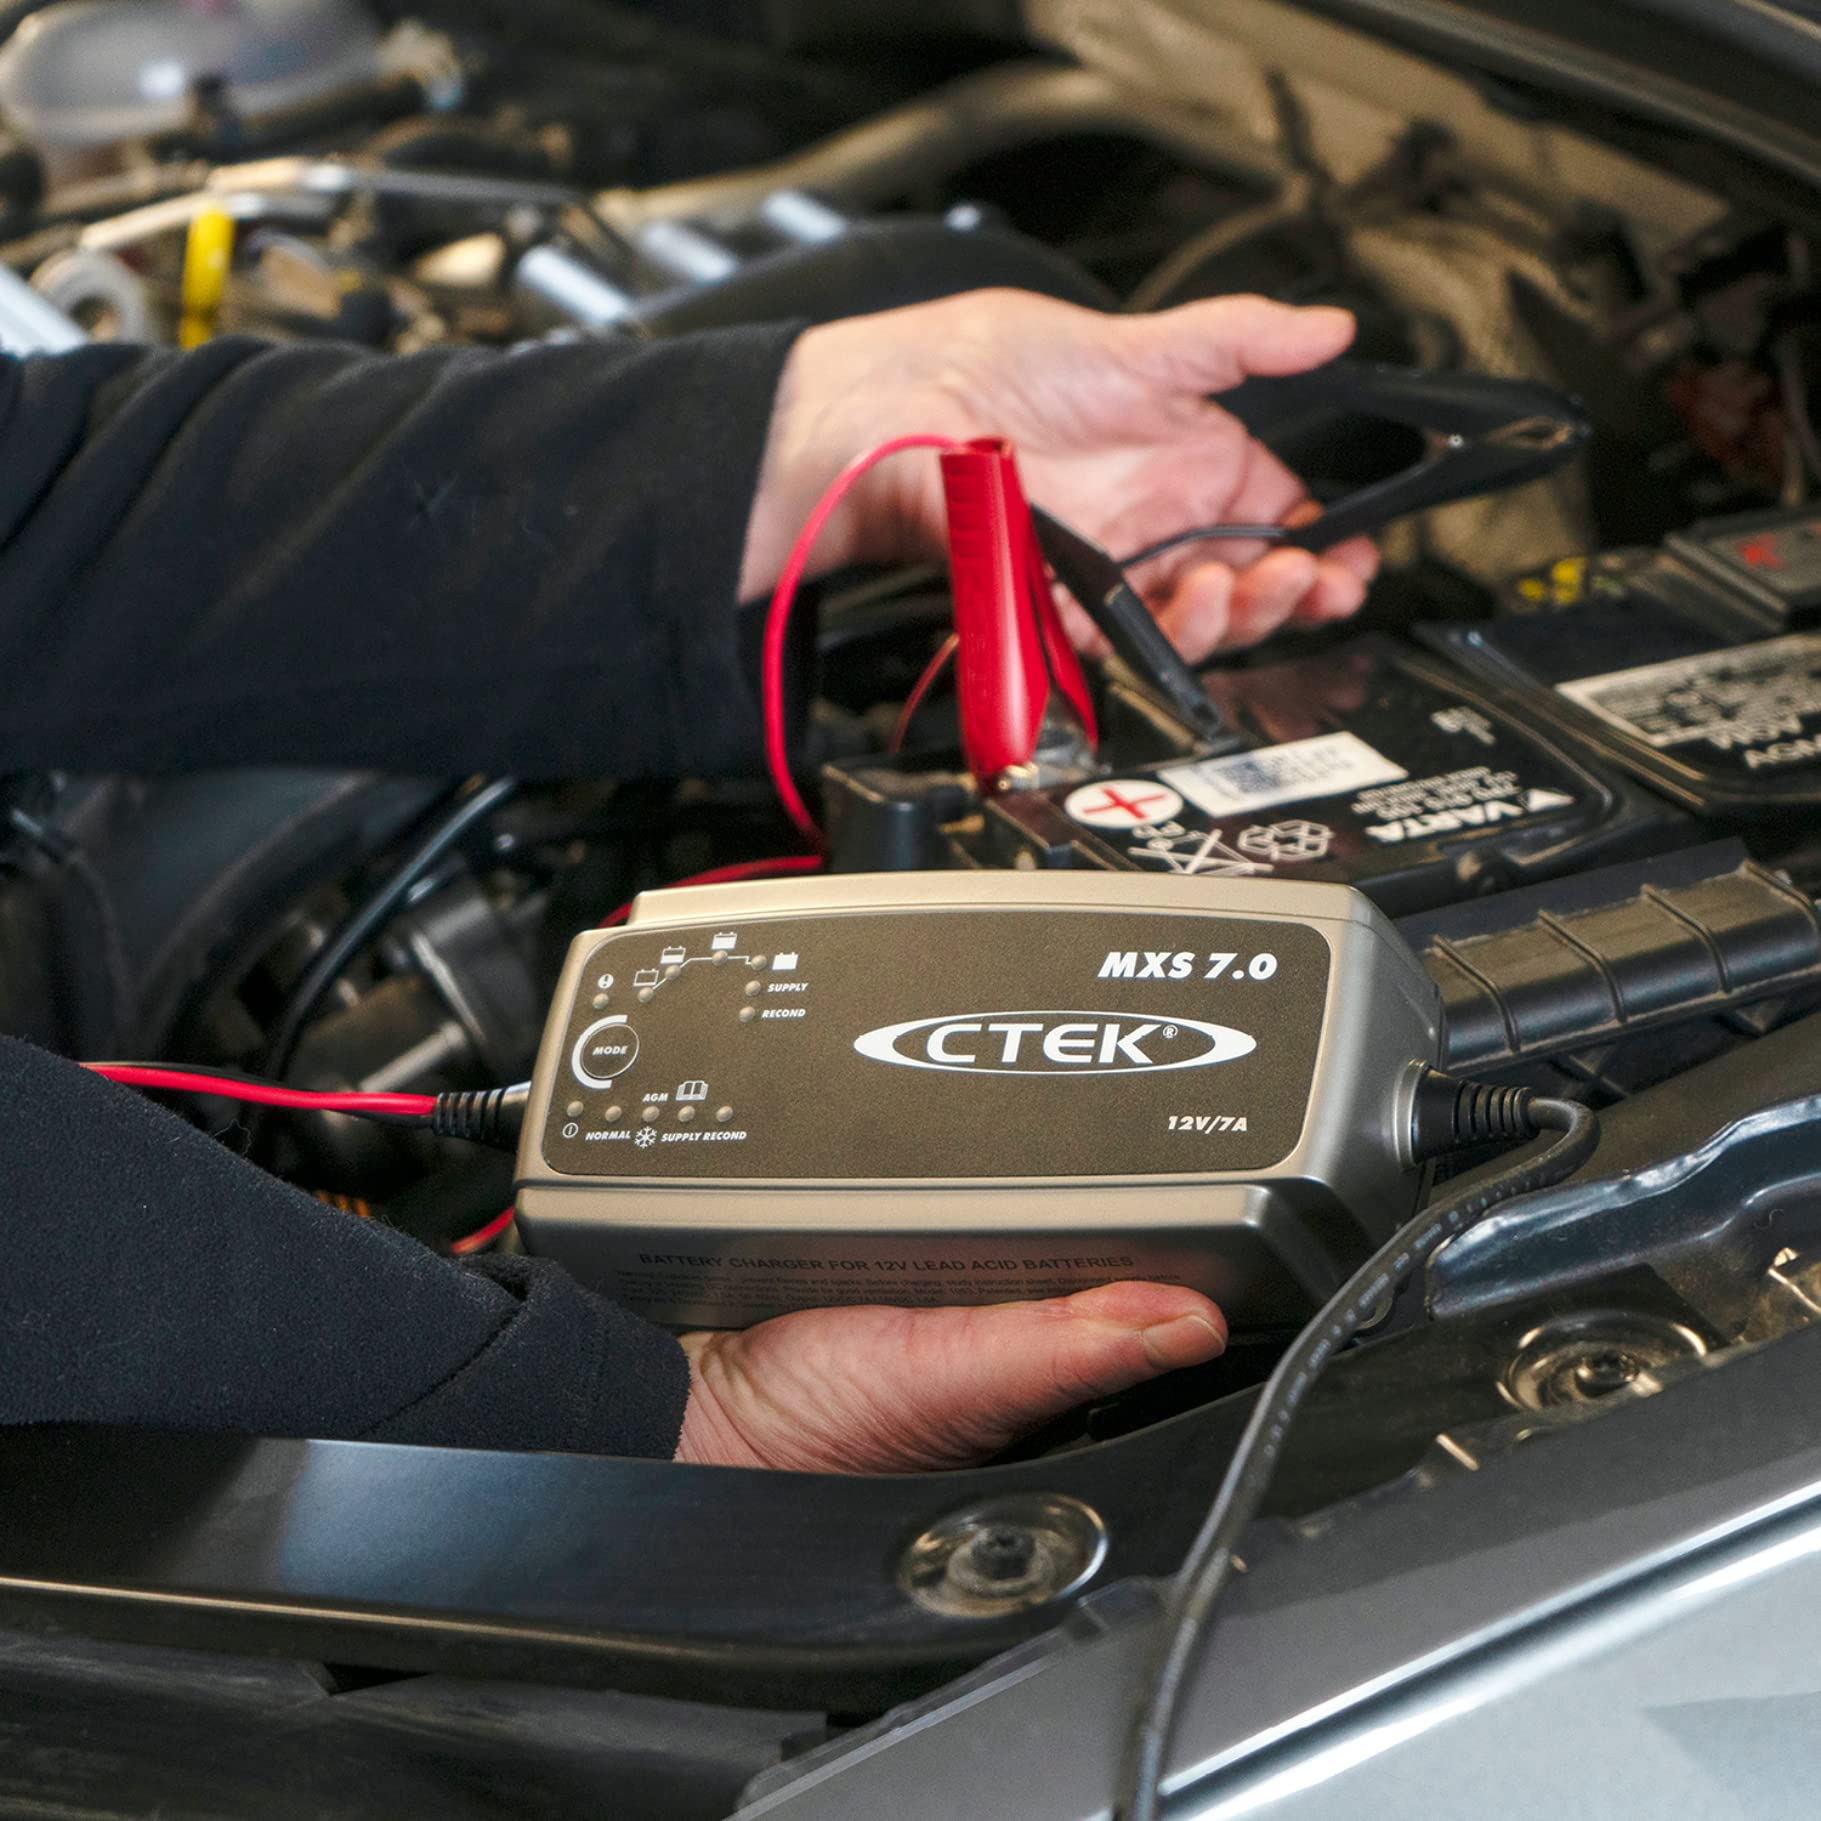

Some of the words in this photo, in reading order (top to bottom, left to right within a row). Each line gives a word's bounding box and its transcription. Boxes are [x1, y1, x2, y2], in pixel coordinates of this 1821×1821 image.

[1097, 951, 1194, 980] MXS
[1203, 952, 1278, 981] 7.0
[767, 982, 808, 993] SUPPLY
[761, 1008, 806, 1019] RECOND
[592, 1045, 628, 1056] MODE
[642, 1092, 669, 1103] AGM
[1167, 1115, 1248, 1134] 12V/7A
[585, 1130, 631, 1141] NORMAL
[661, 1131, 701, 1143] SUPPLY
[702, 1131, 747, 1141] RECOND
[639, 1253, 722, 1268] BATTERY
[729, 1257, 823, 1270] CHARGER
[829, 1259, 869, 1271] FOR
[875, 1260, 907, 1271] 12V
[913, 1259, 965, 1271] LEAD
[971, 1258, 1017, 1270] ACID
[1022, 1255, 1134, 1270] BATTERIES
